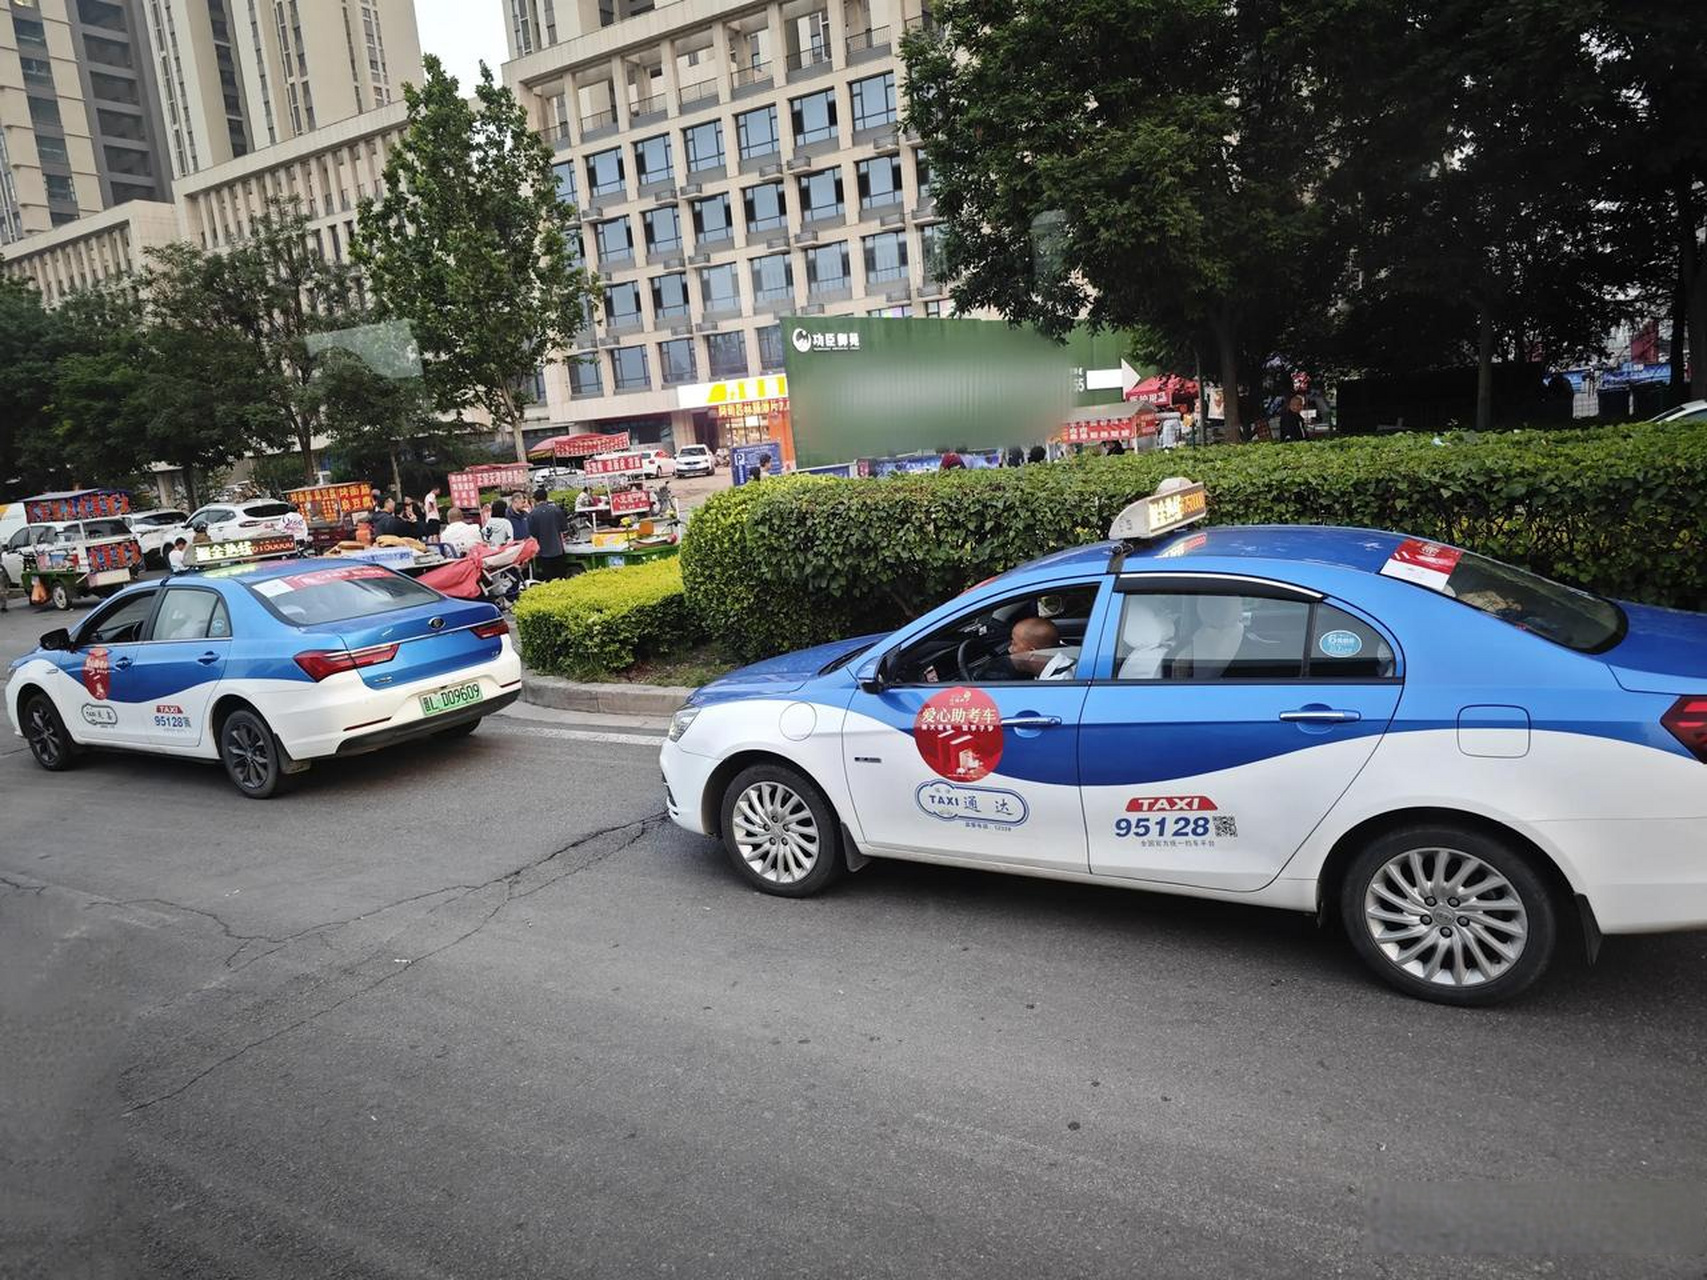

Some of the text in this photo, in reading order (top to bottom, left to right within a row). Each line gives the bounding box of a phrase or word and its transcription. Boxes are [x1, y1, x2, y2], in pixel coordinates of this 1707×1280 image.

[160, 705, 179, 714] TAXI
[922, 707, 997, 724] 爱心助考车
[154, 715, 184, 728] 95128
[929, 795, 959, 807] TAXI
[1138, 797, 1200, 811] TAXI
[1115, 816, 1210, 837] 95128
